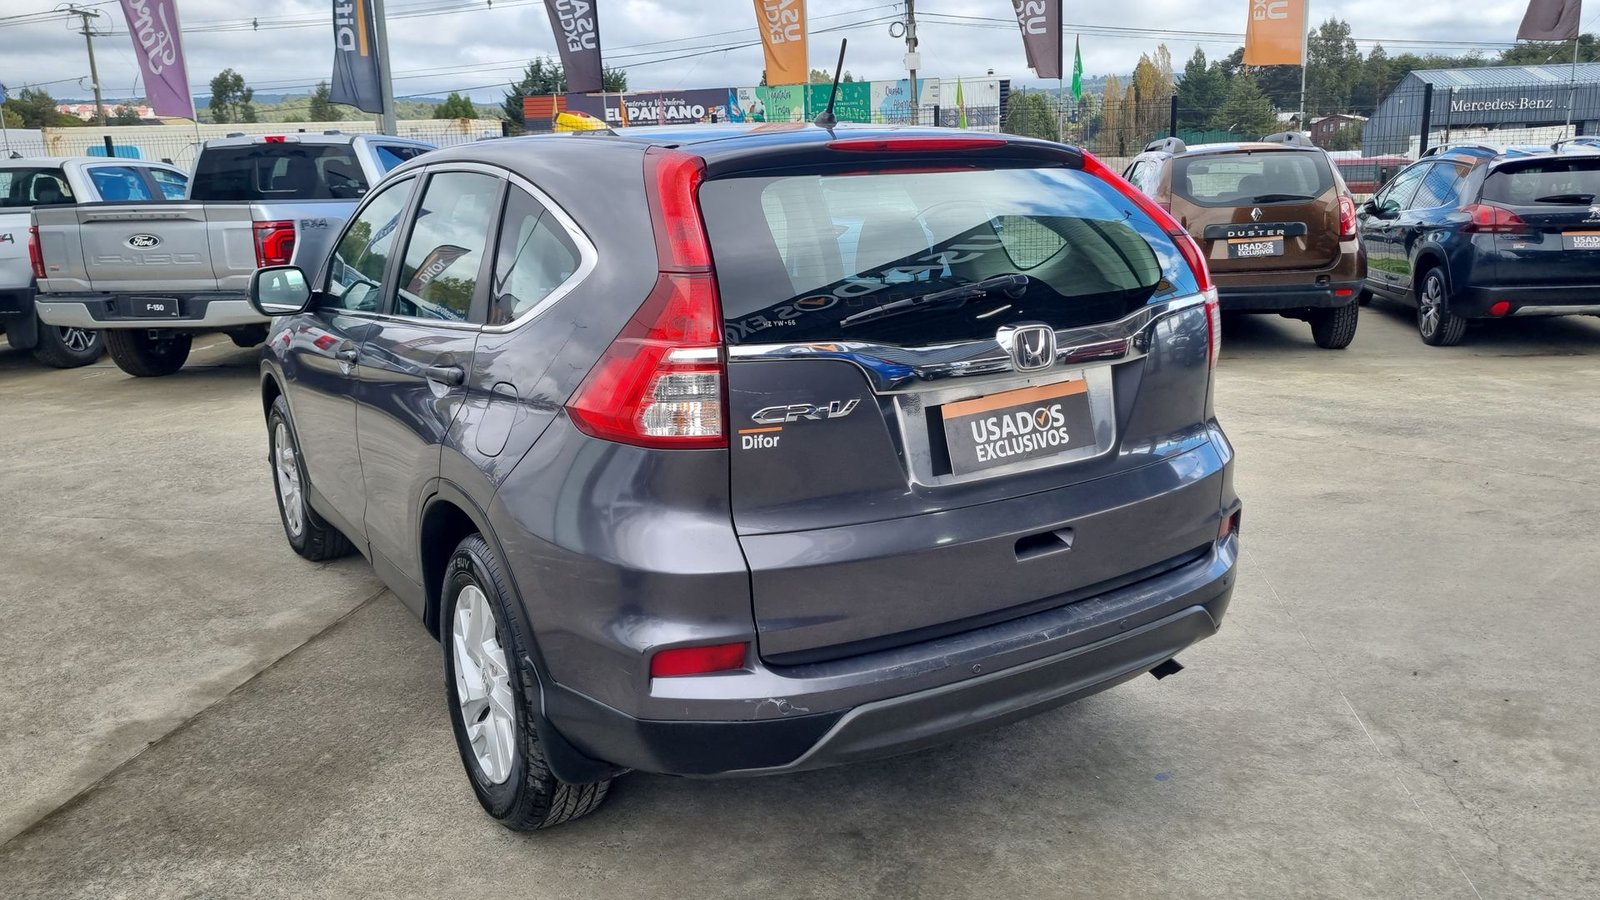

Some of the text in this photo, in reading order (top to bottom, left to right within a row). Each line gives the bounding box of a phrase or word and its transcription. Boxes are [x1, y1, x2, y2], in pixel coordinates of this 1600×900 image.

[1451, 97, 1553, 112] Mercedes-Benz
[605, 105, 705, 121] EL PAISANO
[1228, 229, 1285, 237] DUSTER
[133, 236, 154, 247] Ford
[1238, 242, 1274, 251] USADOS
[1238, 248, 1274, 257] EXCLUSIVOS
[146, 303, 165, 312] F-150
[752, 399, 860, 424] CR-V
[971, 404, 1065, 444] USADOS
[742, 434, 780, 450] Difor
[975, 427, 1070, 462] EXCLUSIVOS
